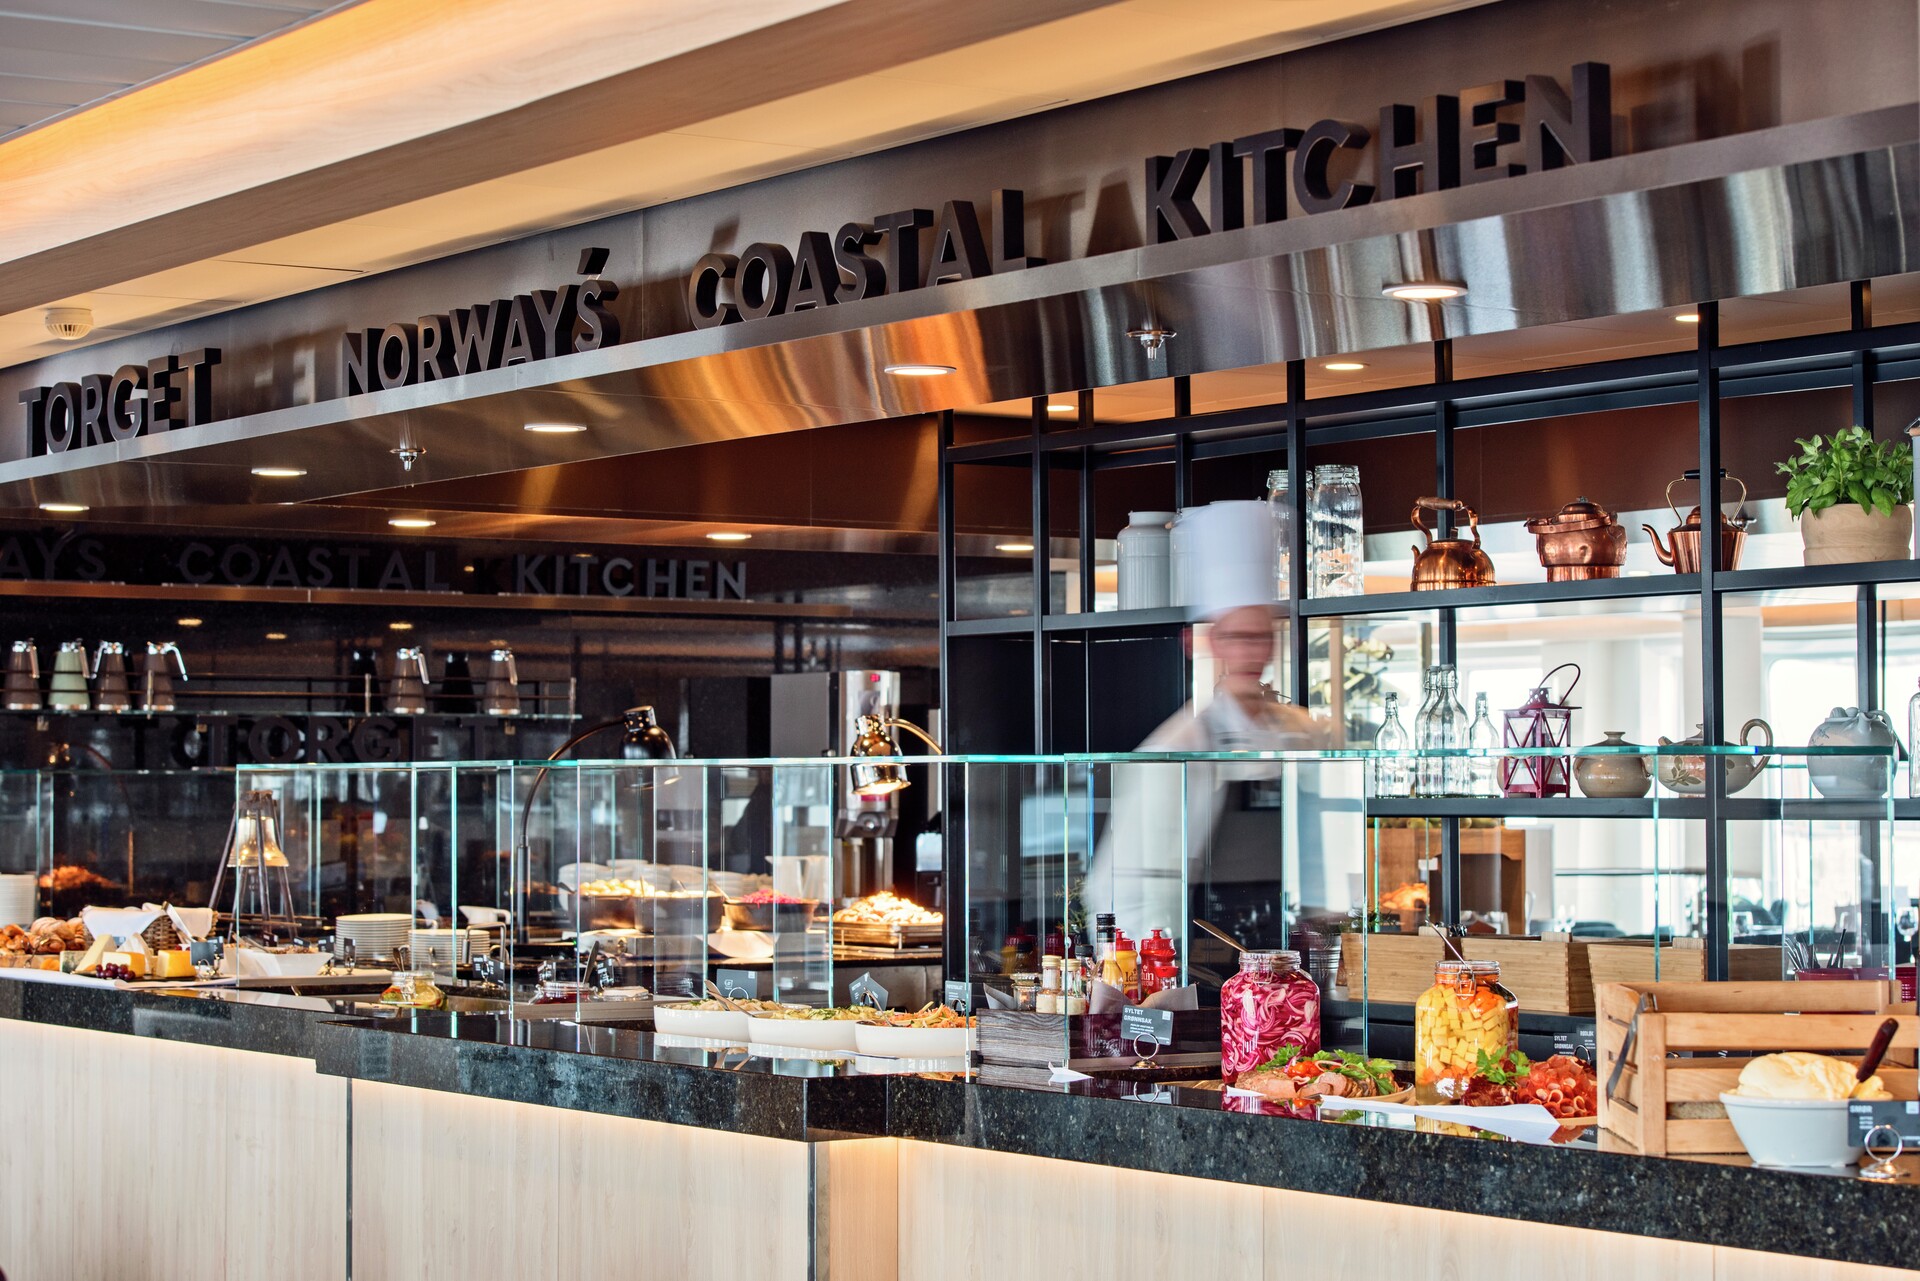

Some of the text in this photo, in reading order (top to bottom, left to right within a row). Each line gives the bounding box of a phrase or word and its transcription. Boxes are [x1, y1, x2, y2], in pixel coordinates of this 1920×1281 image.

[19, 347, 221, 457] TORGET
[688, 189, 1047, 330] COASTAL
[1144, 61, 1610, 246] KITCHEN
[178, 542, 451, 592] COASTAL
[515, 554, 748, 600] KITCHEN
